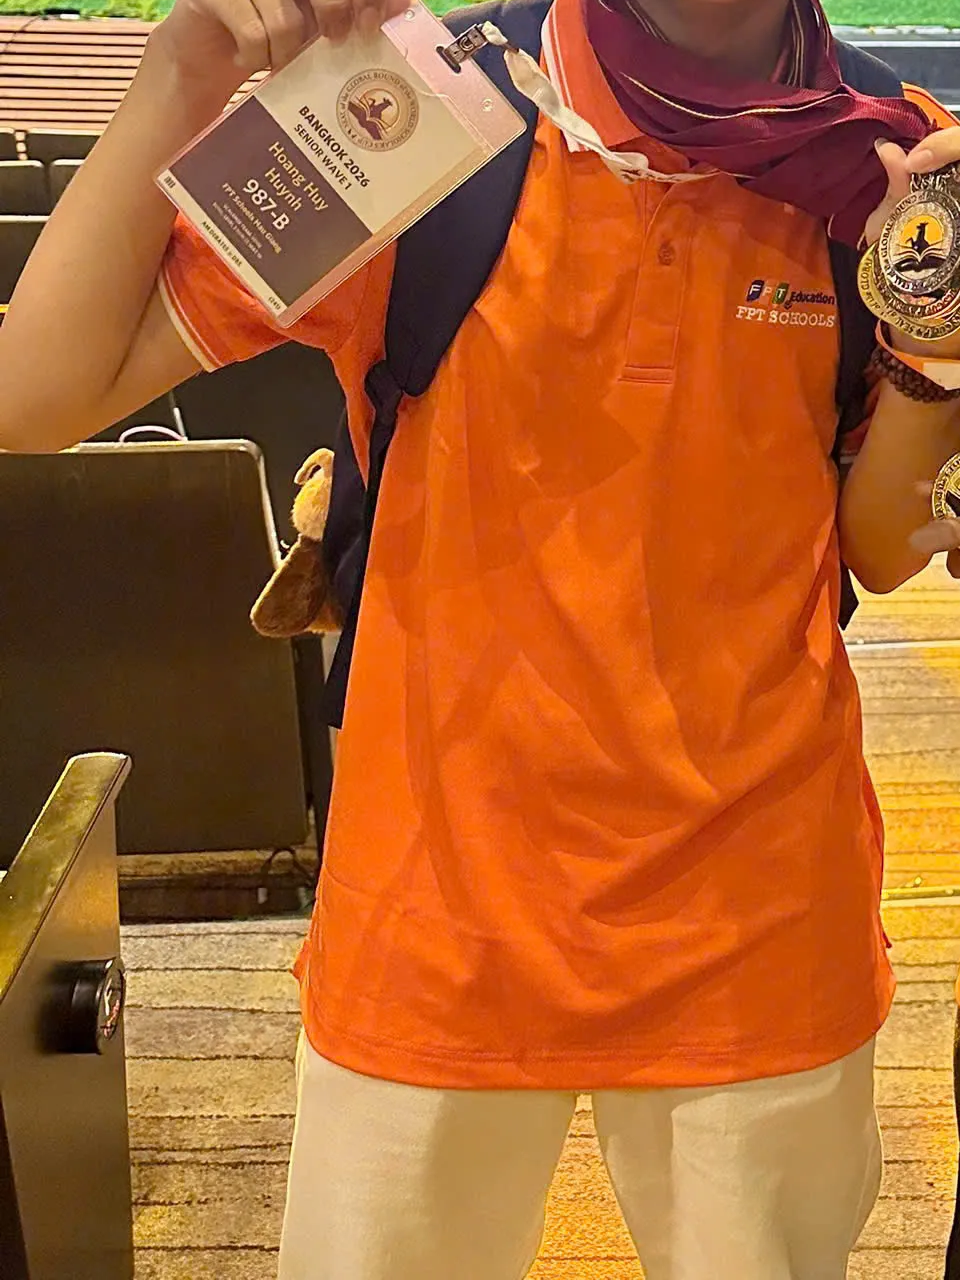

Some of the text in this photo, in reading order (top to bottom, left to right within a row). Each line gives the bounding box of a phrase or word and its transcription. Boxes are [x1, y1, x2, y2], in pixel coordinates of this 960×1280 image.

[345, 72, 371, 93] GLOBAL
[373, 71, 401, 85] ROUND
[294, 124, 352, 190] SENIOR WAVE 1
[298, 106, 370, 187] BANGKOK 2026
[265, 167, 302, 211] Huynh
[269, 141, 329, 211] Hoang Huy
[222, 183, 237, 197] FPT
[232, 194, 255, 222] Schools
[243, 179, 290, 230] 987-B
[881, 223, 893, 258] GLOBAL
[748, 282, 836, 305] FPT Education
[736, 305, 835, 327] FPT SCHOOLS
